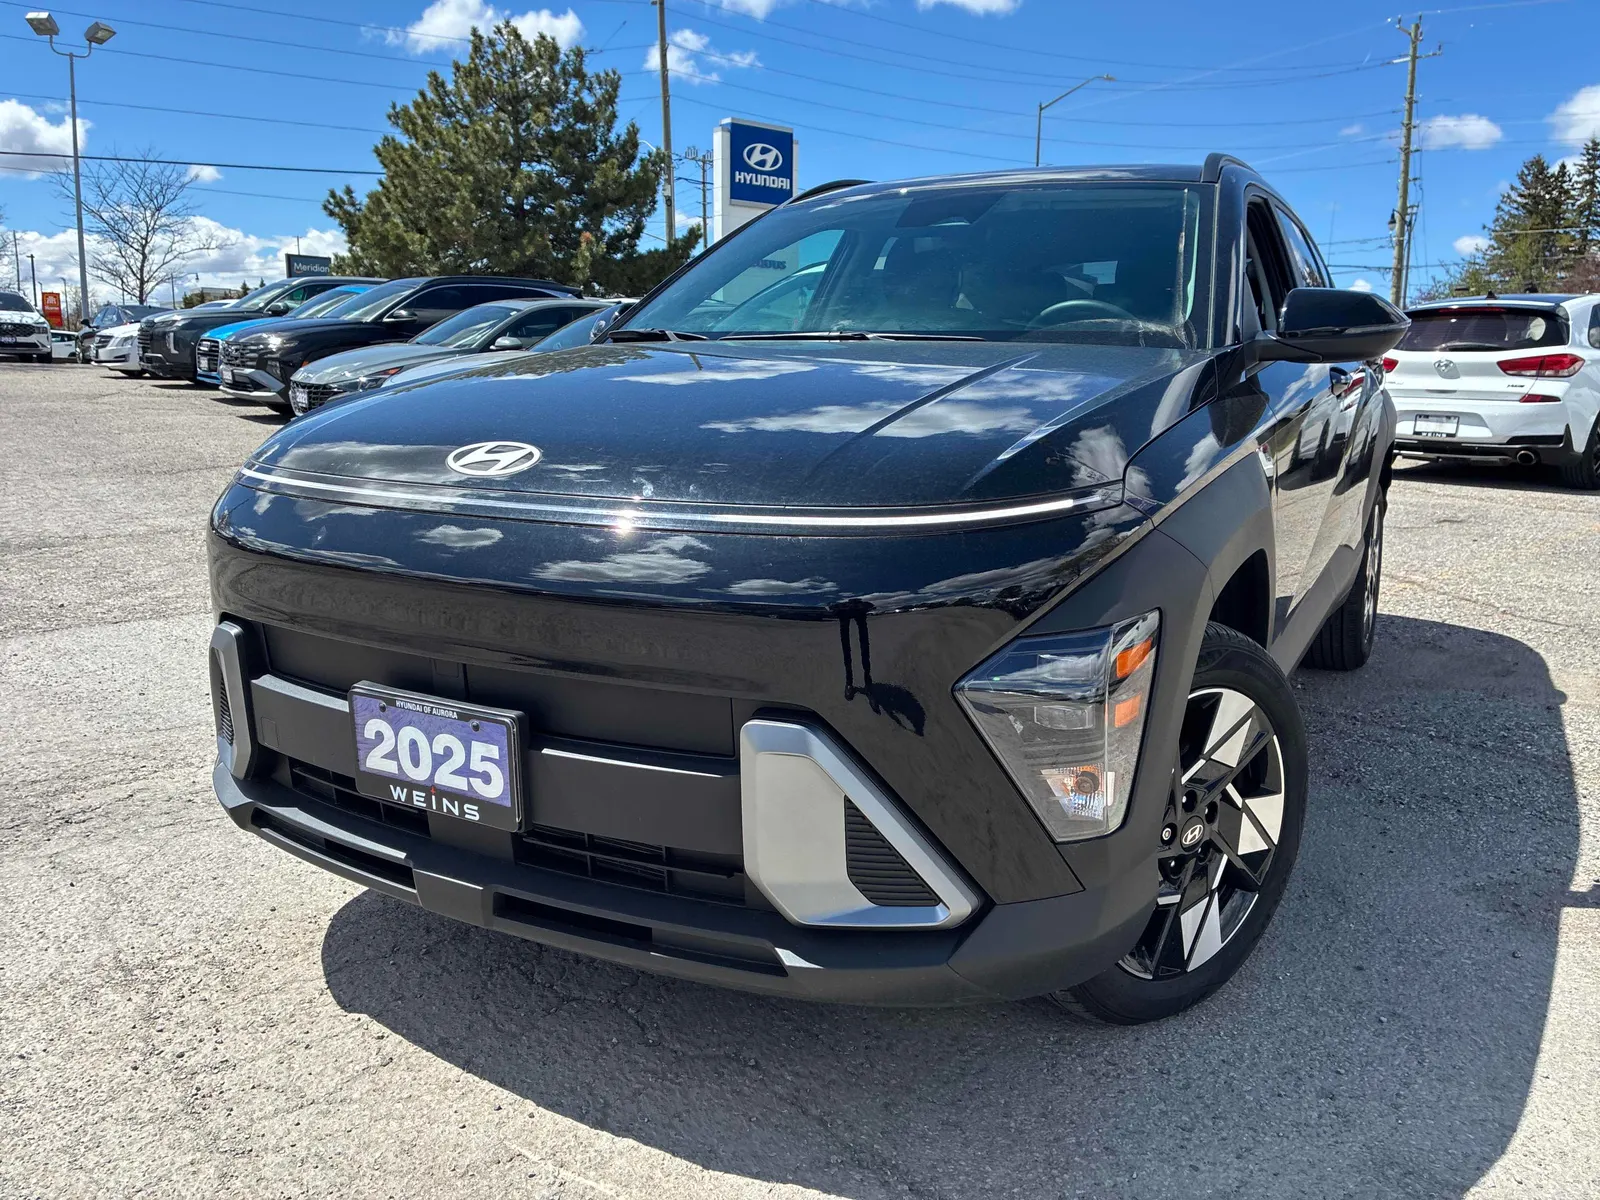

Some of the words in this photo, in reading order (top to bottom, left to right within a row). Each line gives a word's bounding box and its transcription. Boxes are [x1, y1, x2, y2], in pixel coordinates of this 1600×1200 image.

[735, 171, 791, 189] HYUNDAI
[294, 262, 330, 273] Meridian
[396, 700, 423, 712] HYUNDAI
[424, 705, 432, 714] OF
[432, 707, 458, 719] AURORA
[364, 718, 504, 798] 2025
